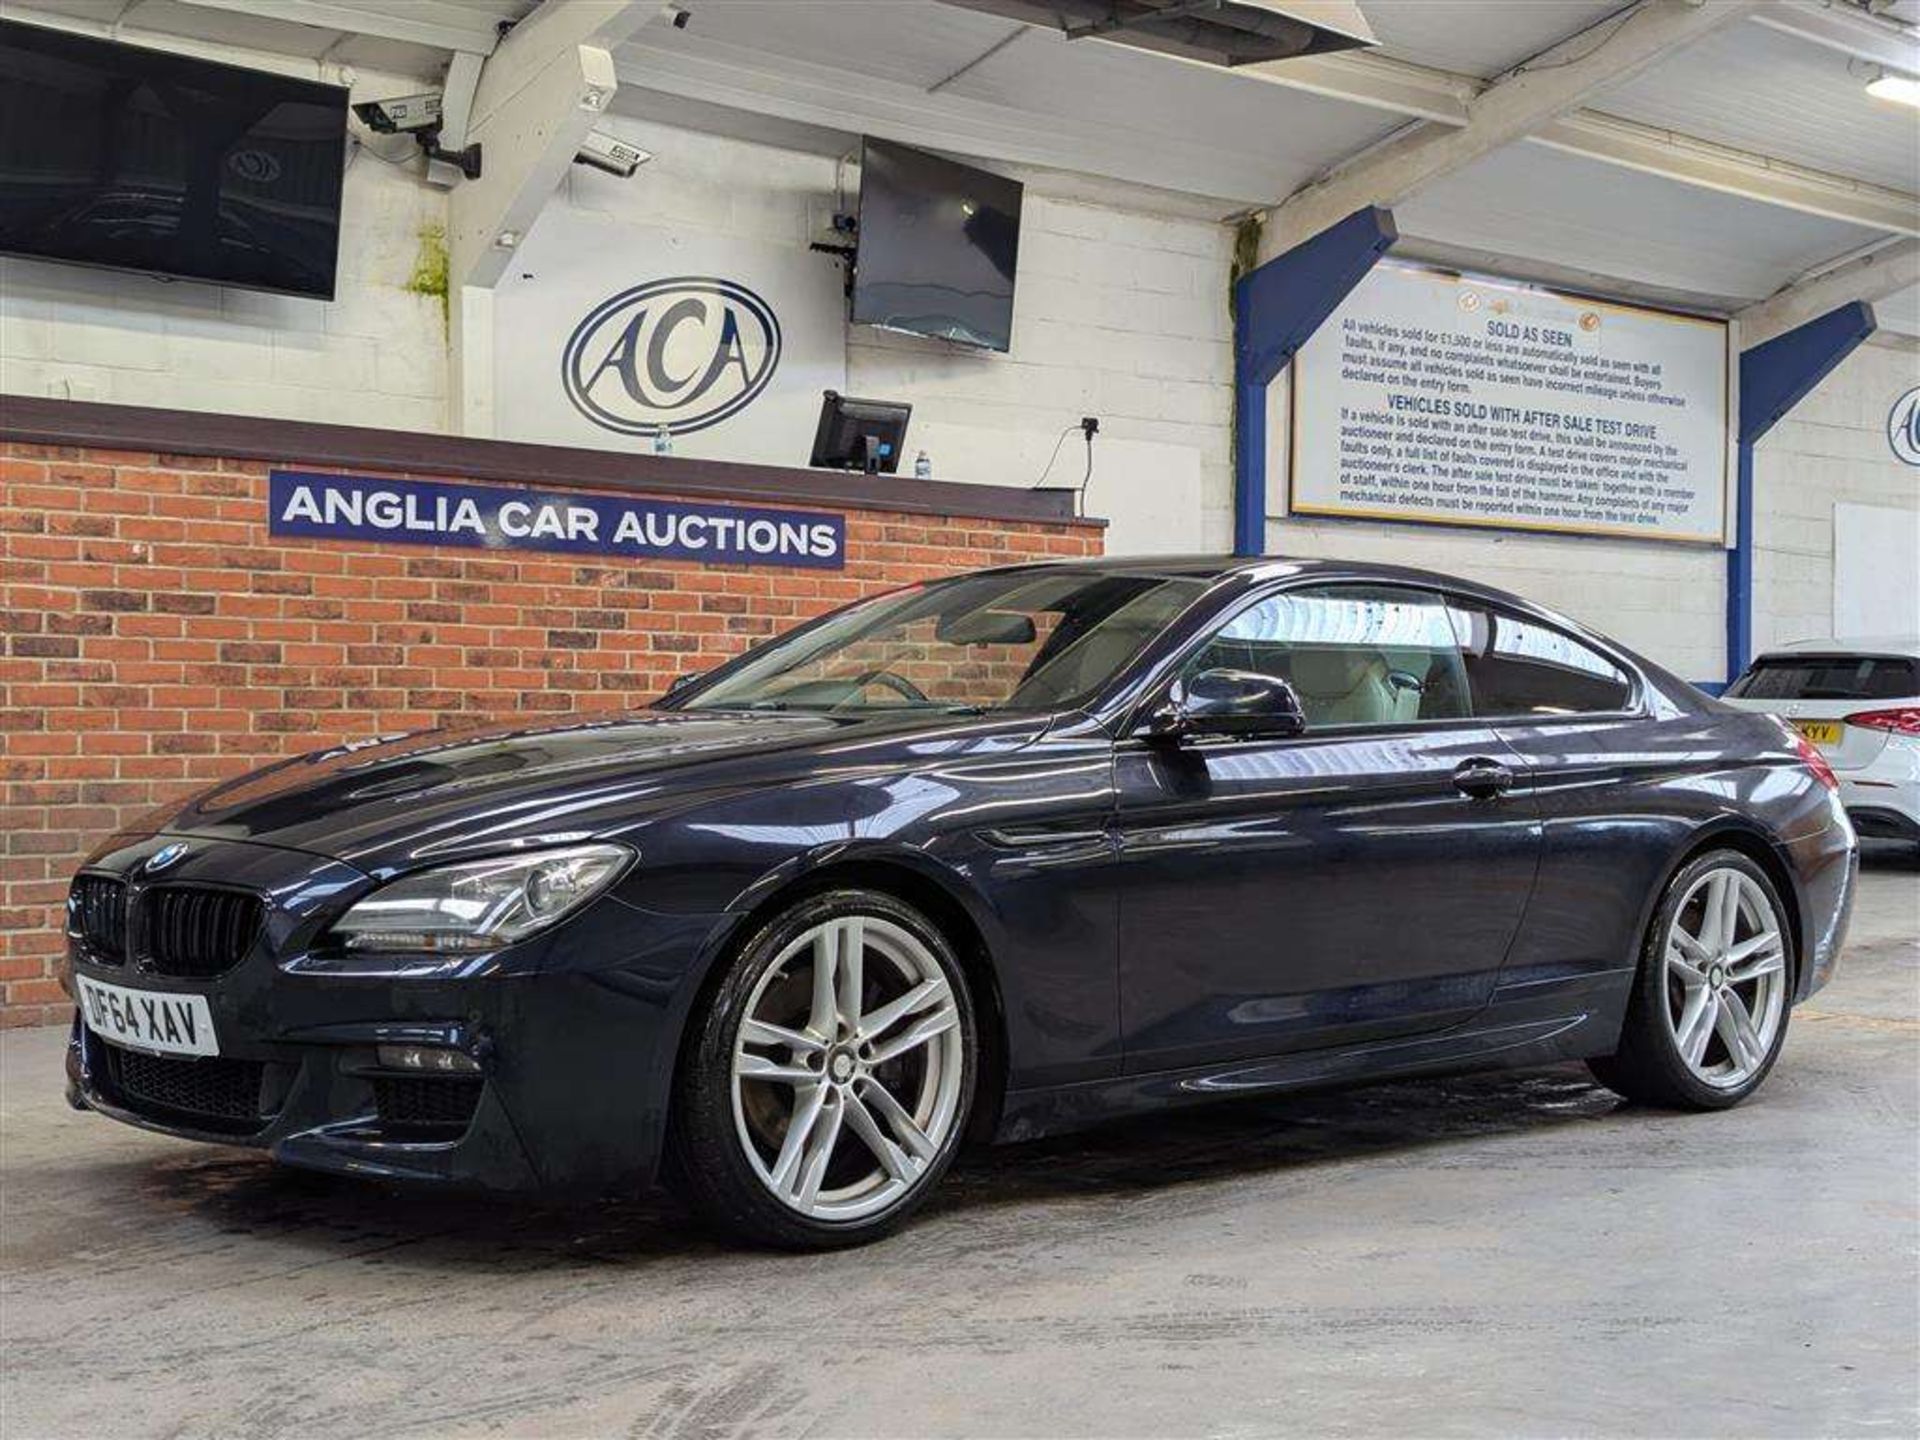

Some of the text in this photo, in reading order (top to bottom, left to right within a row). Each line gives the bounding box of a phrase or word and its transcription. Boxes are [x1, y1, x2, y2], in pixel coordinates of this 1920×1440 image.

[581, 298, 753, 408] ACA
[1343, 318, 1355, 330] All
[1358, 322, 1398, 337] vehicles
[1402, 329, 1422, 340] sold
[1425, 331, 1437, 342] for
[1474, 340, 1482, 349] or
[1485, 339, 1502, 351] less
[1506, 345, 1518, 354] are
[1522, 346, 1577, 365] automatically
[1580, 355, 1598, 366] sold
[1601, 358, 1610, 368] as
[1612, 361, 1631, 370] seen
[1633, 361, 1649, 373] with
[1652, 365, 1661, 375] all
[1488, 320, 1572, 347] SOLD AS SEEN
[1342, 353, 1685, 406] must assume all vehicles sold as seen have incorrect mileage unless otherwise
[1342, 367, 1384, 382] declared
[1387, 375, 1399, 384] on
[1402, 375, 1417, 387] the
[1420, 379, 1444, 393] entry
[1378, 341, 1385, 350] if
[1410, 346, 1427, 357] and
[1431, 348, 1441, 358] no
[1445, 348, 1494, 366] complaints
[1497, 356, 1546, 373] whatsoever
[1549, 364, 1569, 376] shall
[1571, 366, 1581, 378] be
[1634, 376, 1662, 390] Buyers
[1341, 408, 1348, 419] If
[1351, 411, 1357, 419] a
[1359, 412, 1393, 424] vehicle
[1397, 415, 1405, 425] is
[1408, 417, 1429, 428] sold
[1431, 420, 1450, 430] with
[1453, 423, 1465, 432] an
[1467, 424, 1488, 434] after
[1490, 426, 1508, 437] sale
[1511, 428, 1527, 437] test
[1556, 433, 1571, 444] this
[1574, 436, 1594, 446] shall
[1596, 438, 1608, 448] be
[1609, 441, 1651, 453] announced
[1654, 444, 1663, 456] by
[1665, 446, 1677, 456] the
[1388, 394, 1657, 439] VEHICLES SOLD WITH AFTER SALE TEST DRIVE
[1341, 426, 1392, 440] auctioneer
[1396, 432, 1413, 443] and
[1416, 433, 1457, 448] declared
[1459, 439, 1470, 449] on
[1473, 438, 1486, 450] the
[1490, 442, 1512, 455] entry
[1539, 446, 1546, 456] A
[1548, 447, 1564, 458] test
[1566, 448, 1587, 460] drive
[1590, 452, 1617, 464] covers
[1620, 453, 1642, 466] major
[1644, 456, 1687, 471] mechanical
[1341, 440, 1368, 453] faults
[1397, 448, 1402, 457] a
[1406, 447, 1420, 459] full
[1423, 449, 1438, 461] list
[1440, 451, 1450, 461] of
[1452, 452, 1476, 465] faults
[1479, 455, 1514, 468] covered
[1517, 459, 1524, 469] is
[1527, 459, 1568, 474] displayed
[1571, 464, 1579, 473] in
[1581, 465, 1593, 475] the
[1595, 465, 1619, 478] office
[1621, 469, 1635, 480] and
[1638, 471, 1654, 482] with
[1656, 473, 1668, 483] the
[1340, 473, 1351, 484] of
[1381, 478, 1410, 489] within
[1412, 480, 1429, 490] one
[1432, 480, 1454, 492] hour
[1457, 483, 1477, 494] from
[1479, 484, 1494, 495] the
[1496, 486, 1509, 497] fall
[1512, 488, 1521, 498] of
[1523, 488, 1536, 499] the
[1578, 494, 1593, 505] Any
[1641, 499, 1650, 509] of
[1652, 501, 1664, 512] any
[1667, 502, 1689, 515] major
[1431, 465, 1449, 477] The
[1452, 467, 1472, 479] after
[1475, 469, 1492, 481] sale
[1496, 472, 1512, 483] test
[1514, 473, 1536, 484] drive
[1538, 476, 1559, 487] must
[1562, 479, 1573, 488] be
[1603, 482, 1636, 494] together
[1639, 485, 1654, 496] with
[1664, 488, 1695, 499] member
[282, 486, 836, 557] ANGLIA CAR AUCTIONS
[1340, 489, 1396, 504] mechanical
[1399, 495, 1434, 507] defects
[1437, 498, 1459, 508] must
[1463, 499, 1473, 509] be
[1476, 501, 1513, 513] reported
[1516, 503, 1541, 515] within
[1544, 507, 1559, 516] one
[1562, 506, 1581, 517] hour
[1584, 508, 1603, 519] from
[1605, 510, 1618, 520] the
[1620, 511, 1634, 522] test
[84, 985, 197, 1044] DF64 XAV
